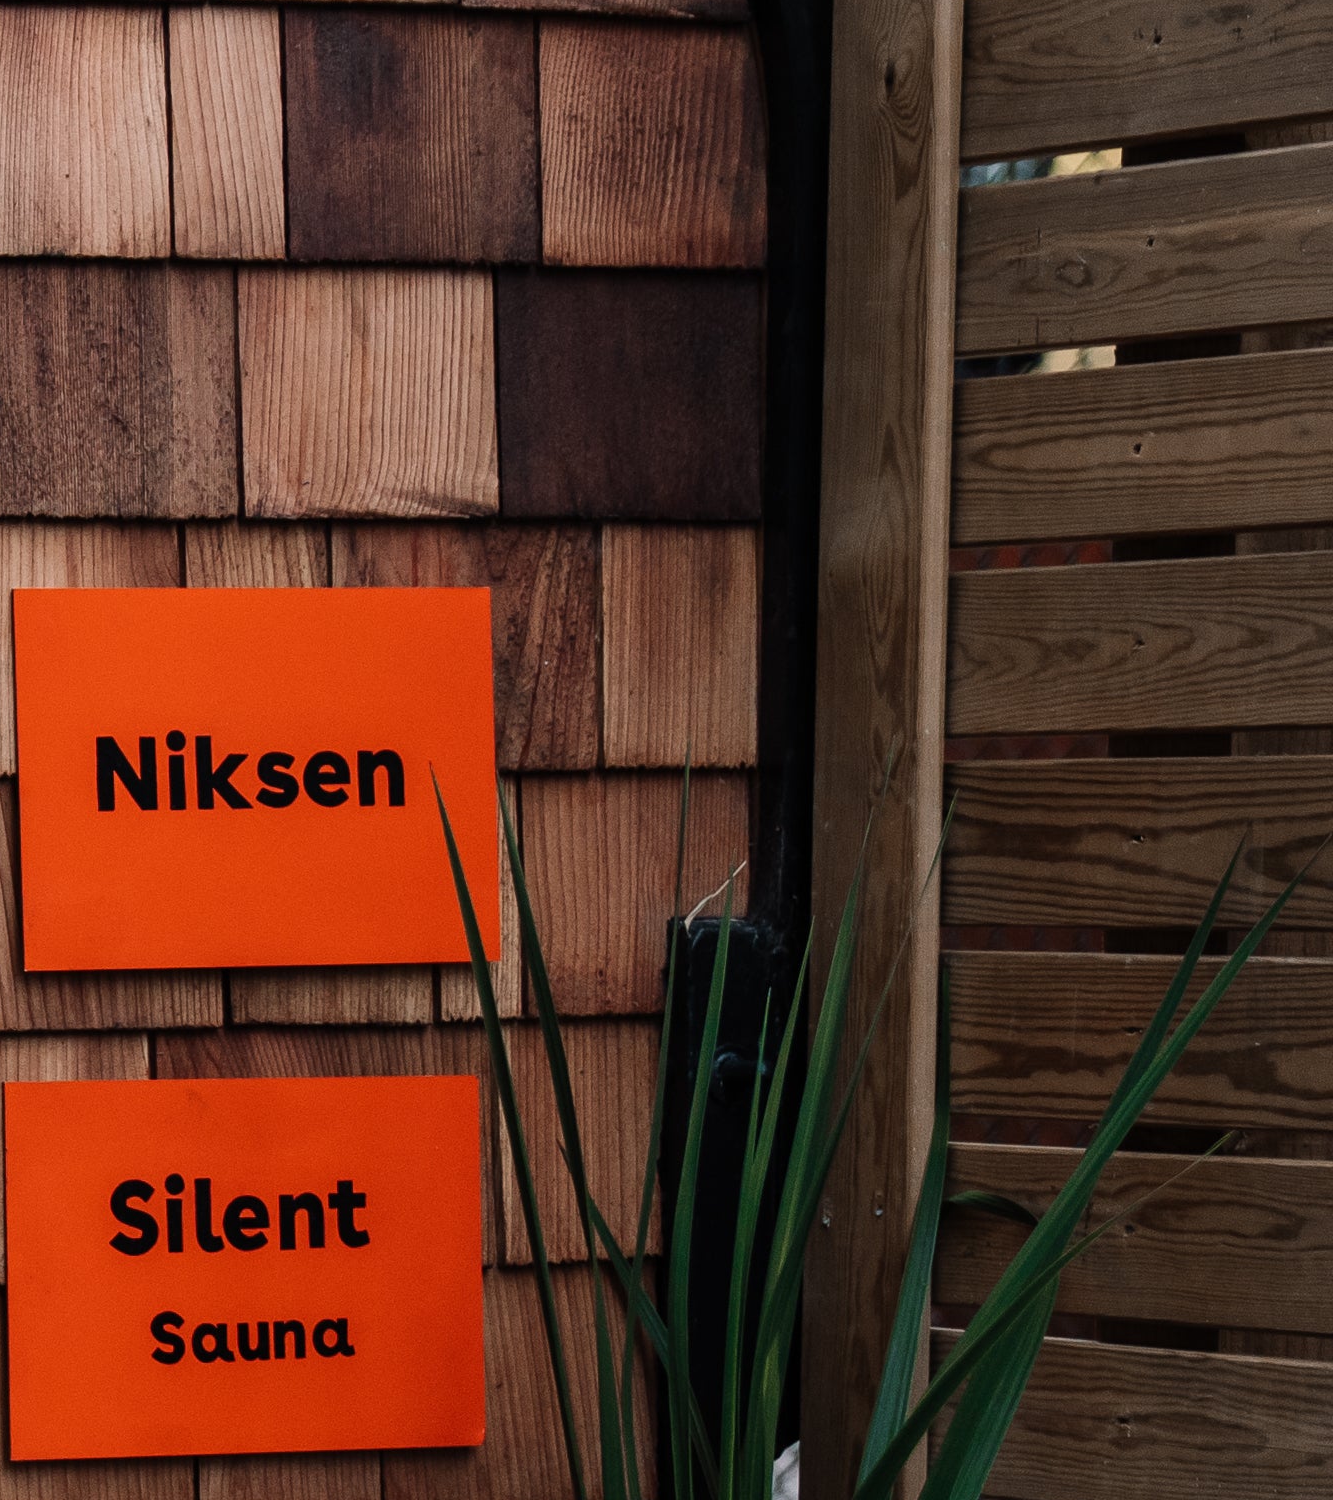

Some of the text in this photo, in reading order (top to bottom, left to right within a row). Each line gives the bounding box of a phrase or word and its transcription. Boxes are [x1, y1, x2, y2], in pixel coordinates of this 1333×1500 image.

[97, 731, 404, 810] Niksen
[111, 1175, 369, 1255] Silent
[151, 1312, 354, 1364] Sauna
